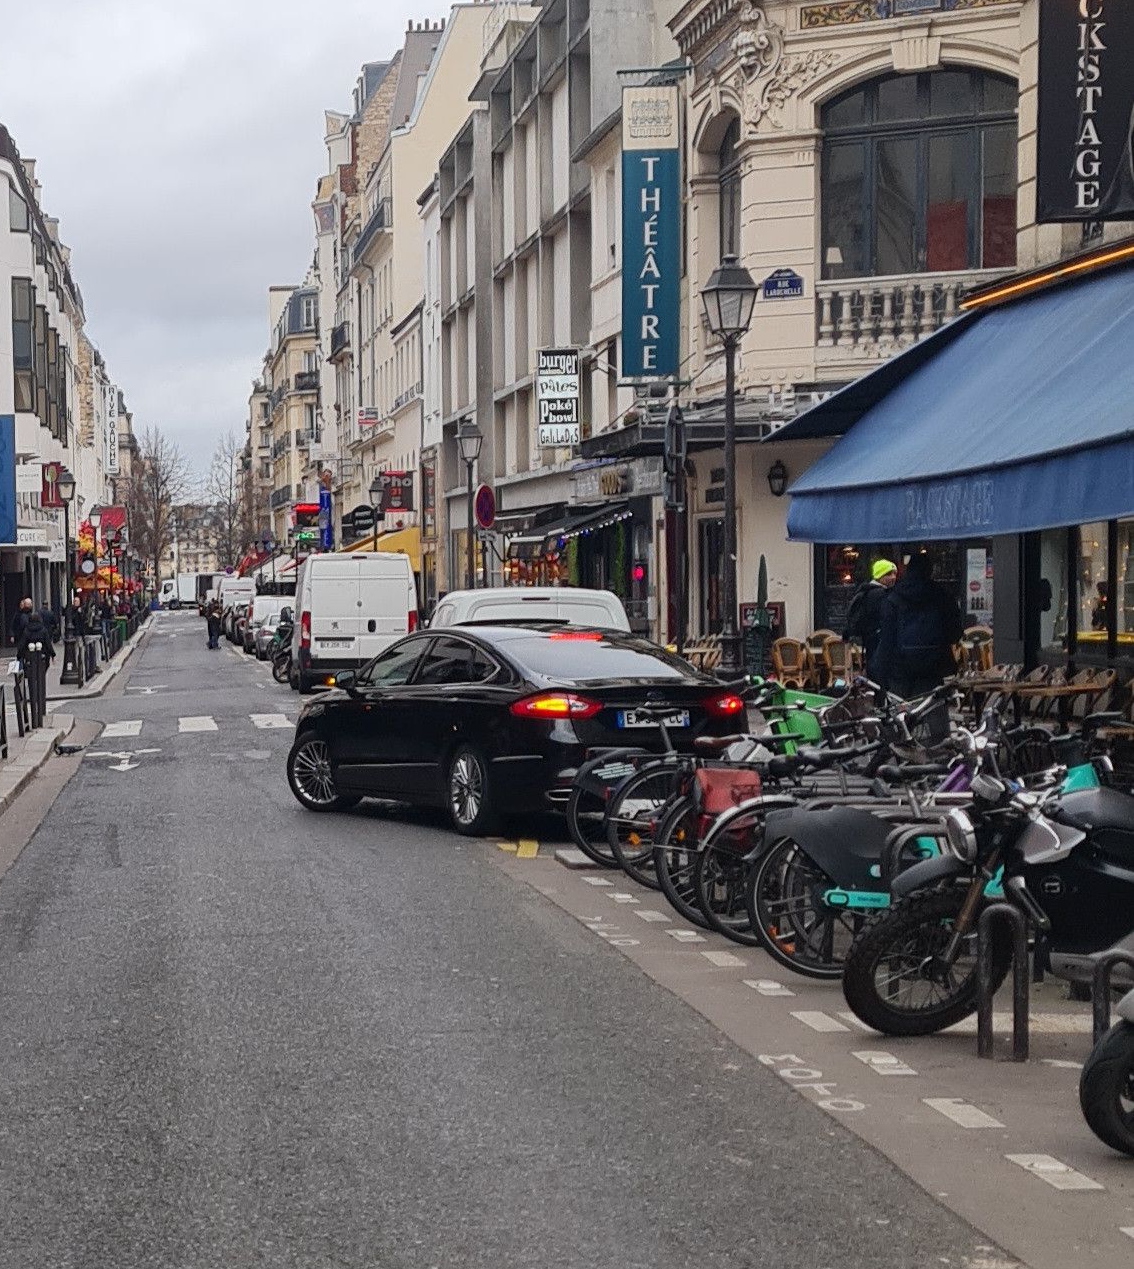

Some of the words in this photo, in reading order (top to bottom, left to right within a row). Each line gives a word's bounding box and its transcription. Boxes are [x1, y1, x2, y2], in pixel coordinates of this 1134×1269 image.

[640, 157, 662, 370] THÉÂTRE
[539, 351, 578, 374] burger
[540, 379, 578, 394] pâtes
[758, 1054, 865, 1112] MOTO
